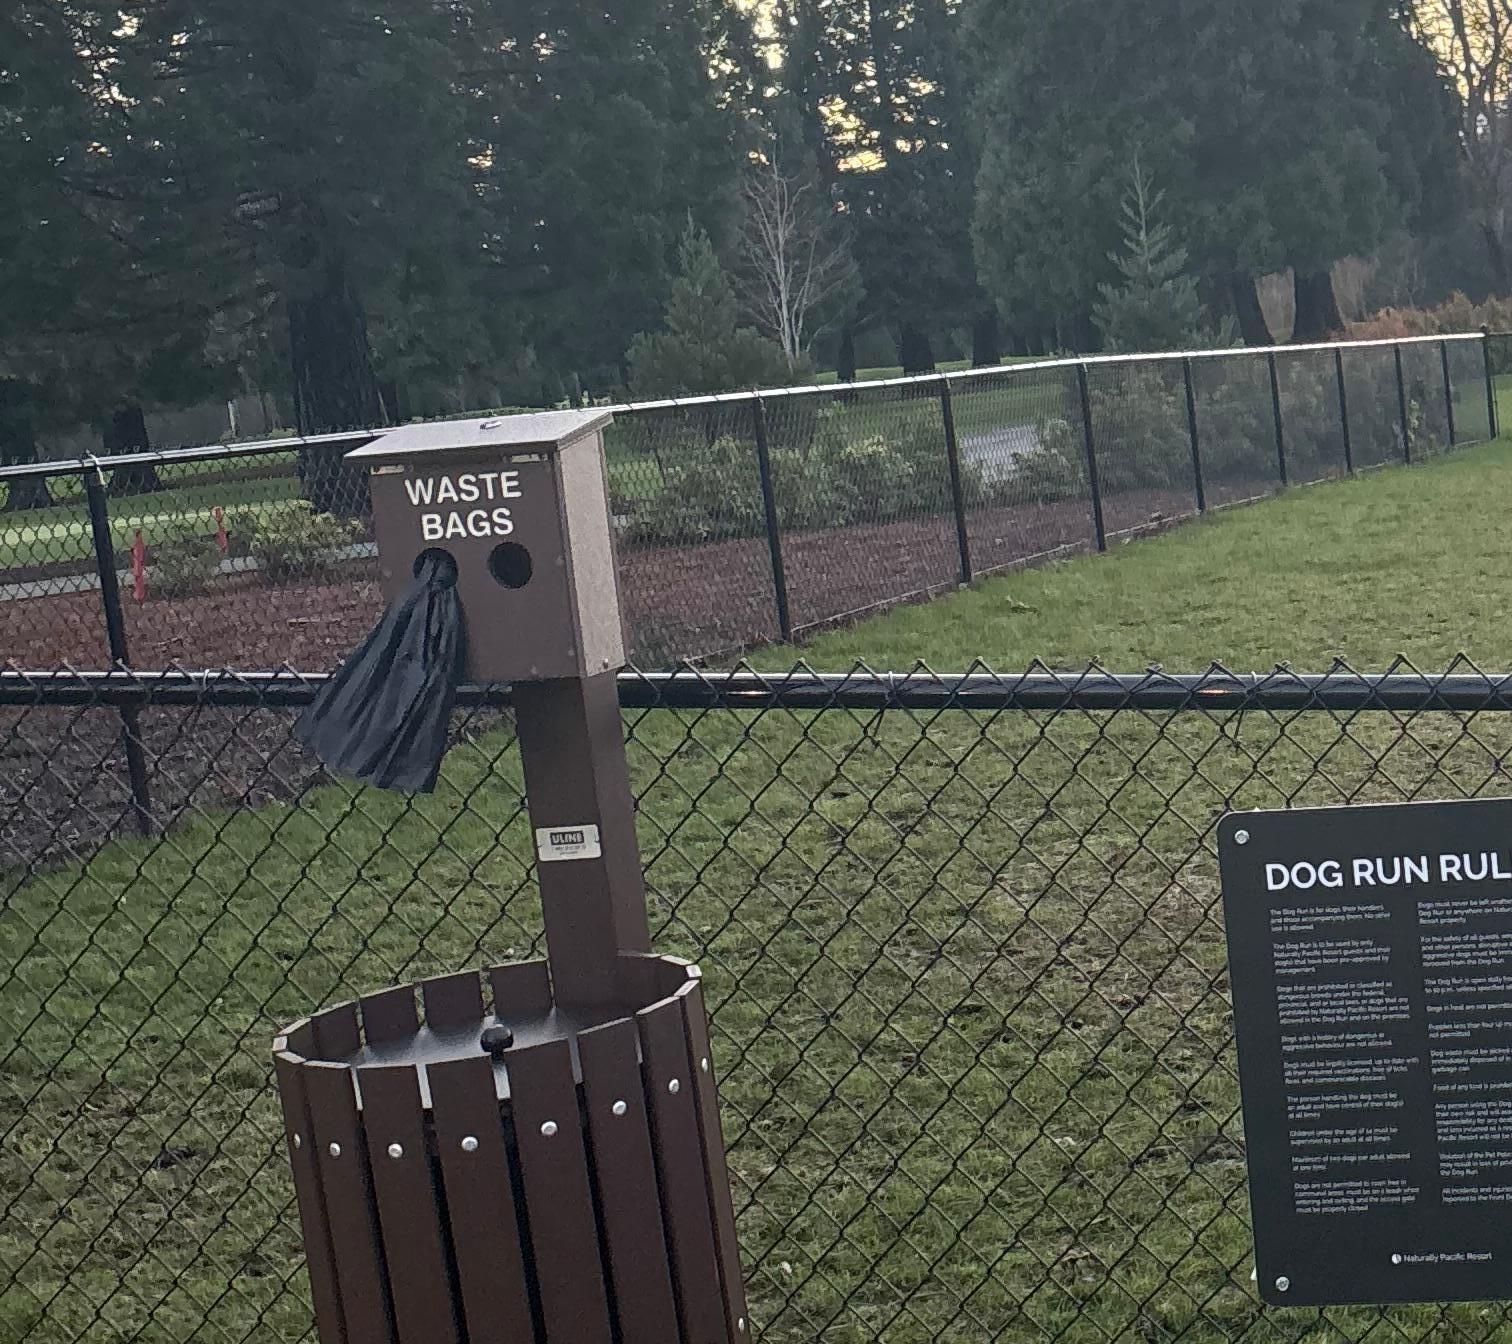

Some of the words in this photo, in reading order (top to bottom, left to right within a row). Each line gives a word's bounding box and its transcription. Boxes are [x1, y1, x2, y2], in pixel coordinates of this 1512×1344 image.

[404, 469, 522, 506] WASTE
[421, 507, 514, 541] BAGS
[551, 832, 583, 844] ULINE
[1265, 860, 1344, 891] DOG
[1353, 855, 1429, 886] RUN
